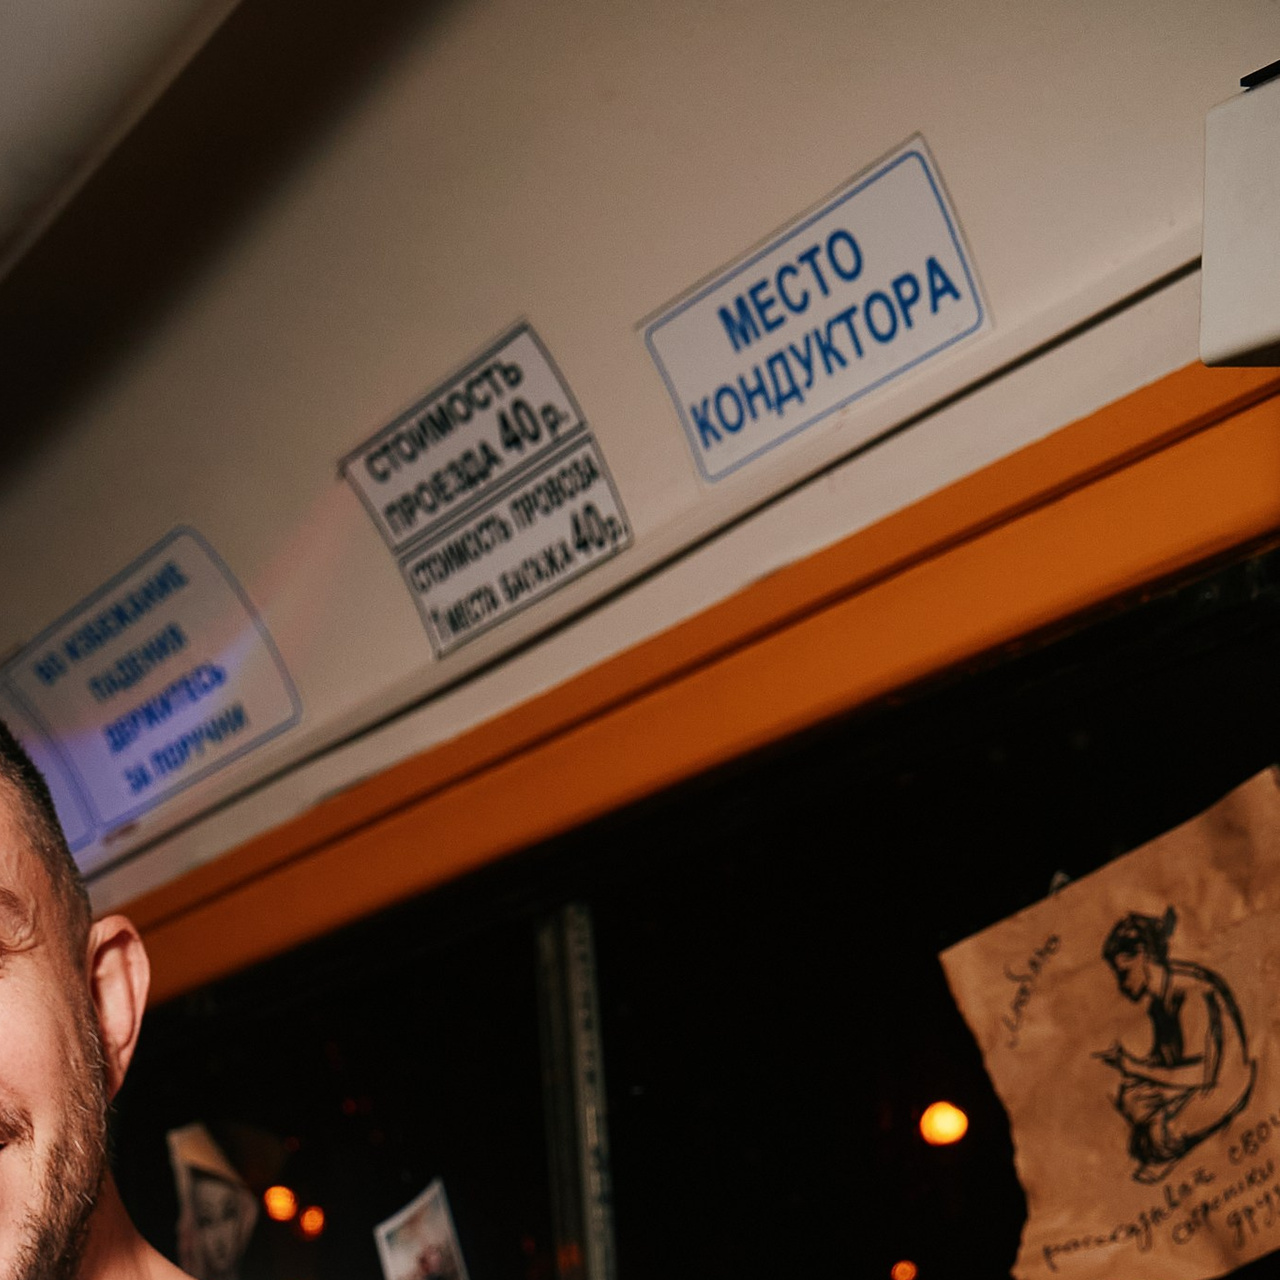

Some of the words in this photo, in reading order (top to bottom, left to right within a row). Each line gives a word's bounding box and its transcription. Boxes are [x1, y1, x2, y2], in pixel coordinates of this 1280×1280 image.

[689, 256, 961, 450] КОНДУКТОРА
[717, 228, 864, 354] МЕСТО
[365, 361, 524, 483] СТОИМОСТЬ
[384, 441, 504, 537] ПРОЕЗДА
[409, 513, 514, 594] СТОИМОСТЬ
[509, 452, 600, 528] ПРОВОЗА
[498, 537, 573, 602] БАГАЖА
